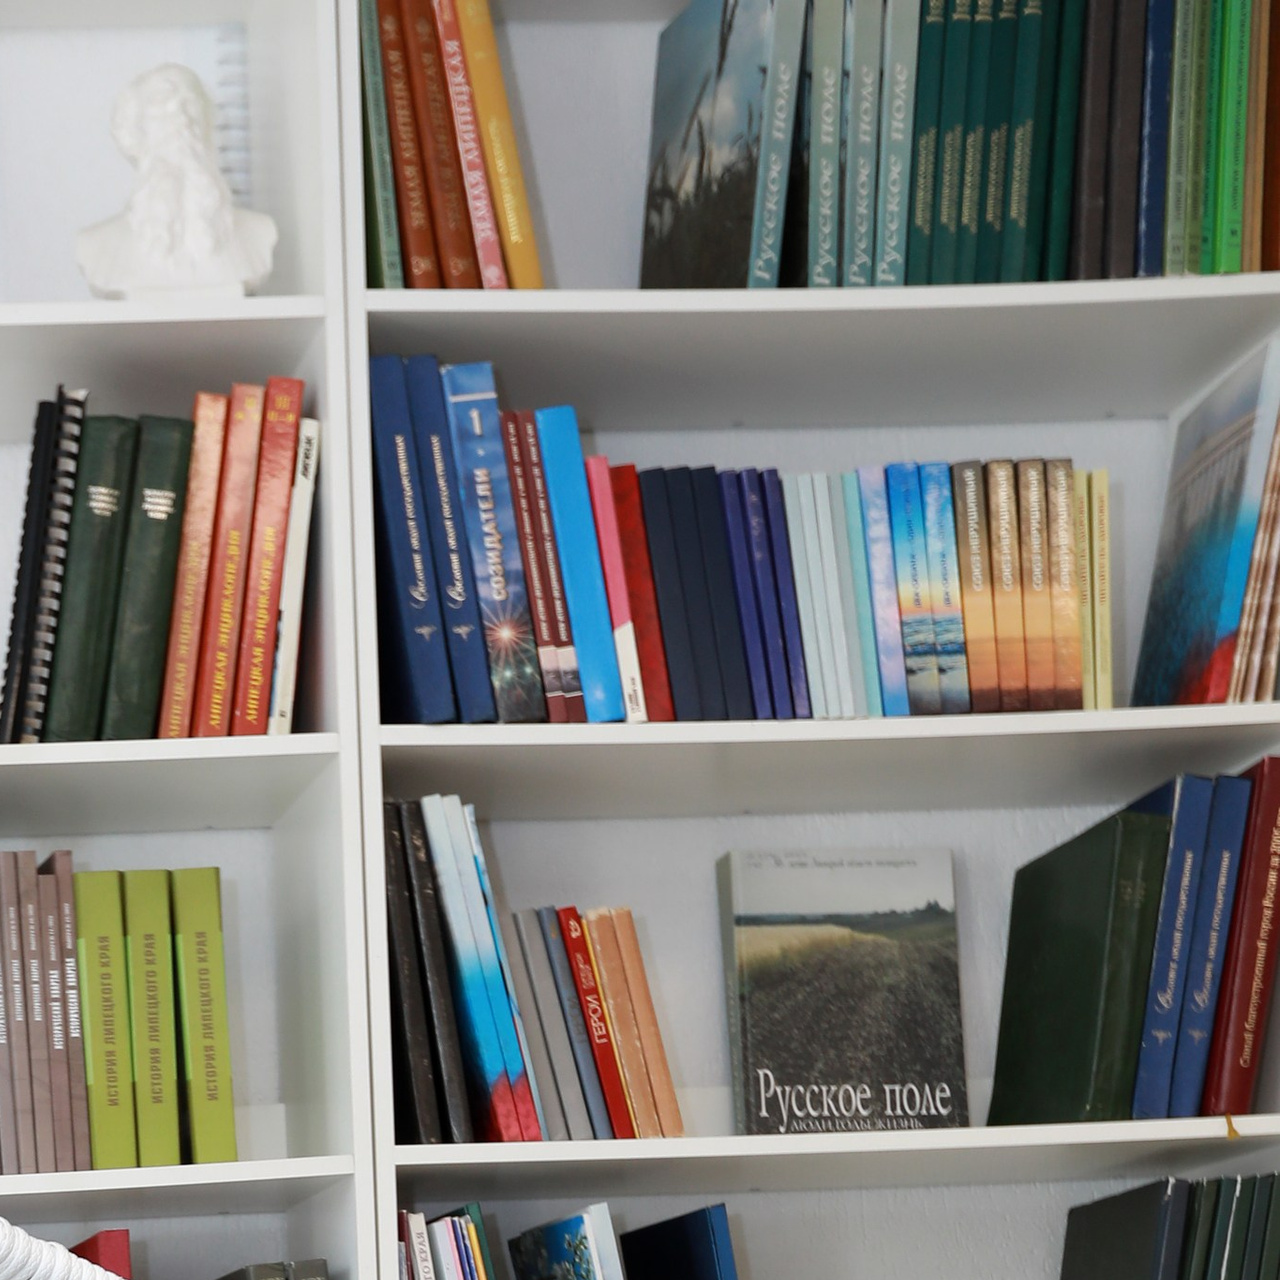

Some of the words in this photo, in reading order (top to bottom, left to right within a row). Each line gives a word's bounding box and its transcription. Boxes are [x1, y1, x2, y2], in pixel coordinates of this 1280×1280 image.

[820, 66, 836, 144] поле
[858, 65, 875, 143] поле
[754, 151, 781, 280] Русское
[773, 62, 793, 139] поле
[877, 154, 903, 281] Русское
[891, 61, 908, 140] поле
[812, 157, 836, 285] Русское
[848, 156, 872, 284] Русское
[473, 467, 508, 602] СОЗИДАТЕЛИ
[208, 652, 235, 728] ЛИПЕЦКАЯ
[244, 647, 269, 724] ЛИПЕЦКАЯ
[64, 958, 77, 986] КВАРТАЛ
[96, 935, 110, 968] КРАЯ
[143, 932, 156, 965] КРАЯ
[194, 930, 209, 963] КРАЯ
[50, 970, 61, 998] КВАРТАЛ
[103, 972, 117, 1045] ЛИПЕЦКОГО
[145, 969, 160, 1043] ЛИПЕЦКОГО
[199, 967, 215, 1040] ЛИПЕЦКОГО
[586, 994, 609, 1044] ГЕРОИ
[107, 1050, 120, 1107] ИСТОРИЯ
[150, 1047, 164, 1104] ИСТОРИЯ
[204, 1044, 219, 1101] ИСТОРИЯ
[756, 1068, 872, 1134] Русское
[882, 1081, 953, 1117] поле
[415, 1231, 430, 1263] КРАЯ
